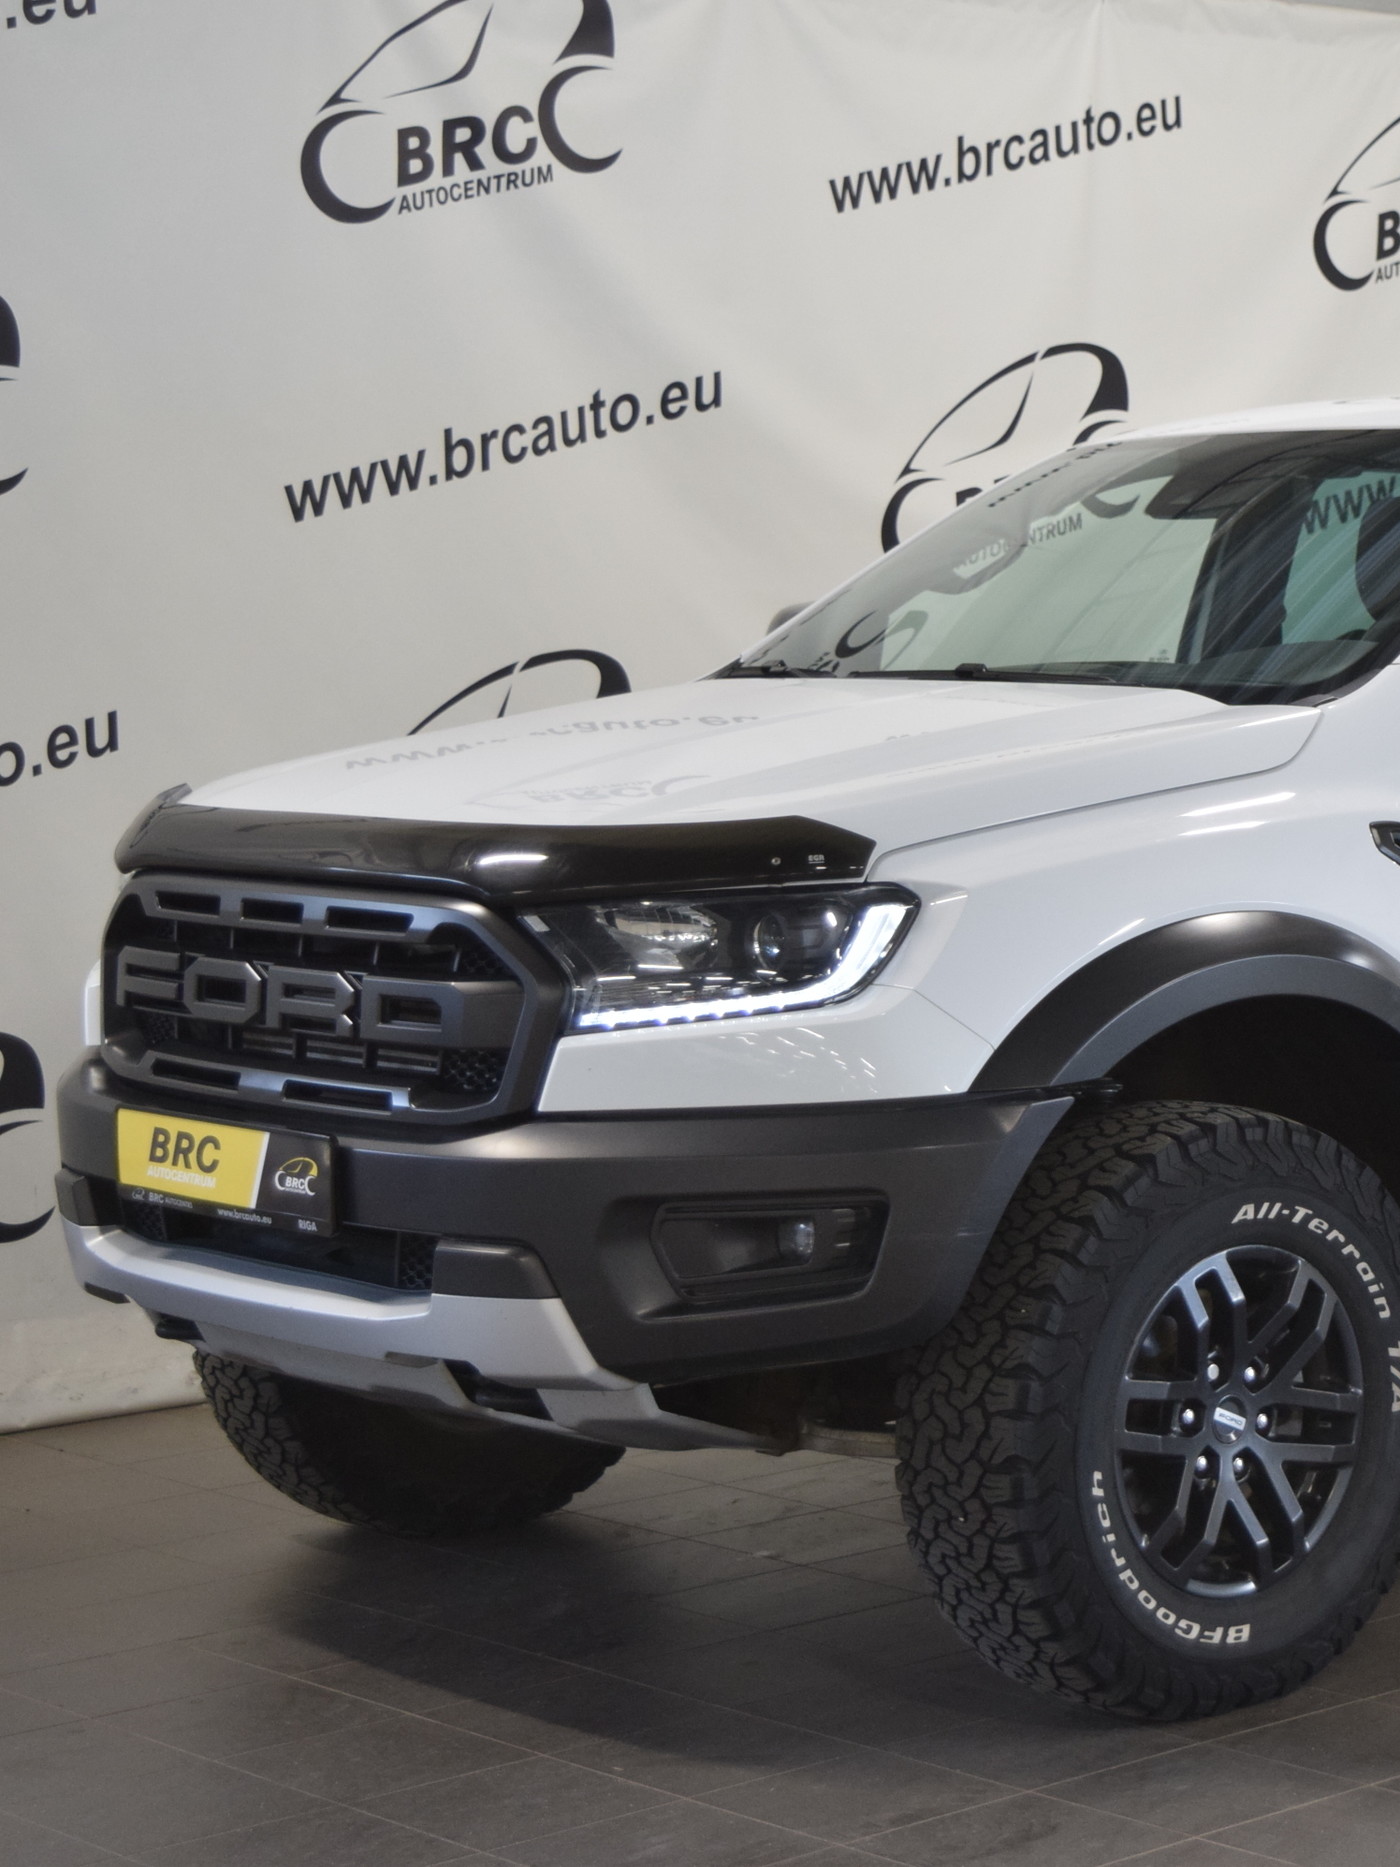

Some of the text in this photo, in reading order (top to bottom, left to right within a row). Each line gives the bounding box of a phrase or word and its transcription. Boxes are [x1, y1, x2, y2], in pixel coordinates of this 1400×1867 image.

[397, 105, 538, 188] BRC
[828, 95, 1183, 214] www.brcauto.eu
[397, 164, 554, 215] AUTOCENTRUM
[284, 370, 722, 523] www.brcauto.eu
[0, 710, 119, 787] o.eu
[807, 854, 825, 862] EGR
[115, 944, 464, 1048] FORD
[147, 1165, 217, 1188] AUTOCENTRUM
[148, 1127, 221, 1173] BRC
[285, 1176, 305, 1190] BRC
[217, 1208, 272, 1224] www.brcauto.eu
[1231, 1202, 1392, 1320] All-Terrain
[1091, 1470, 1252, 1645] BFGoodrich
